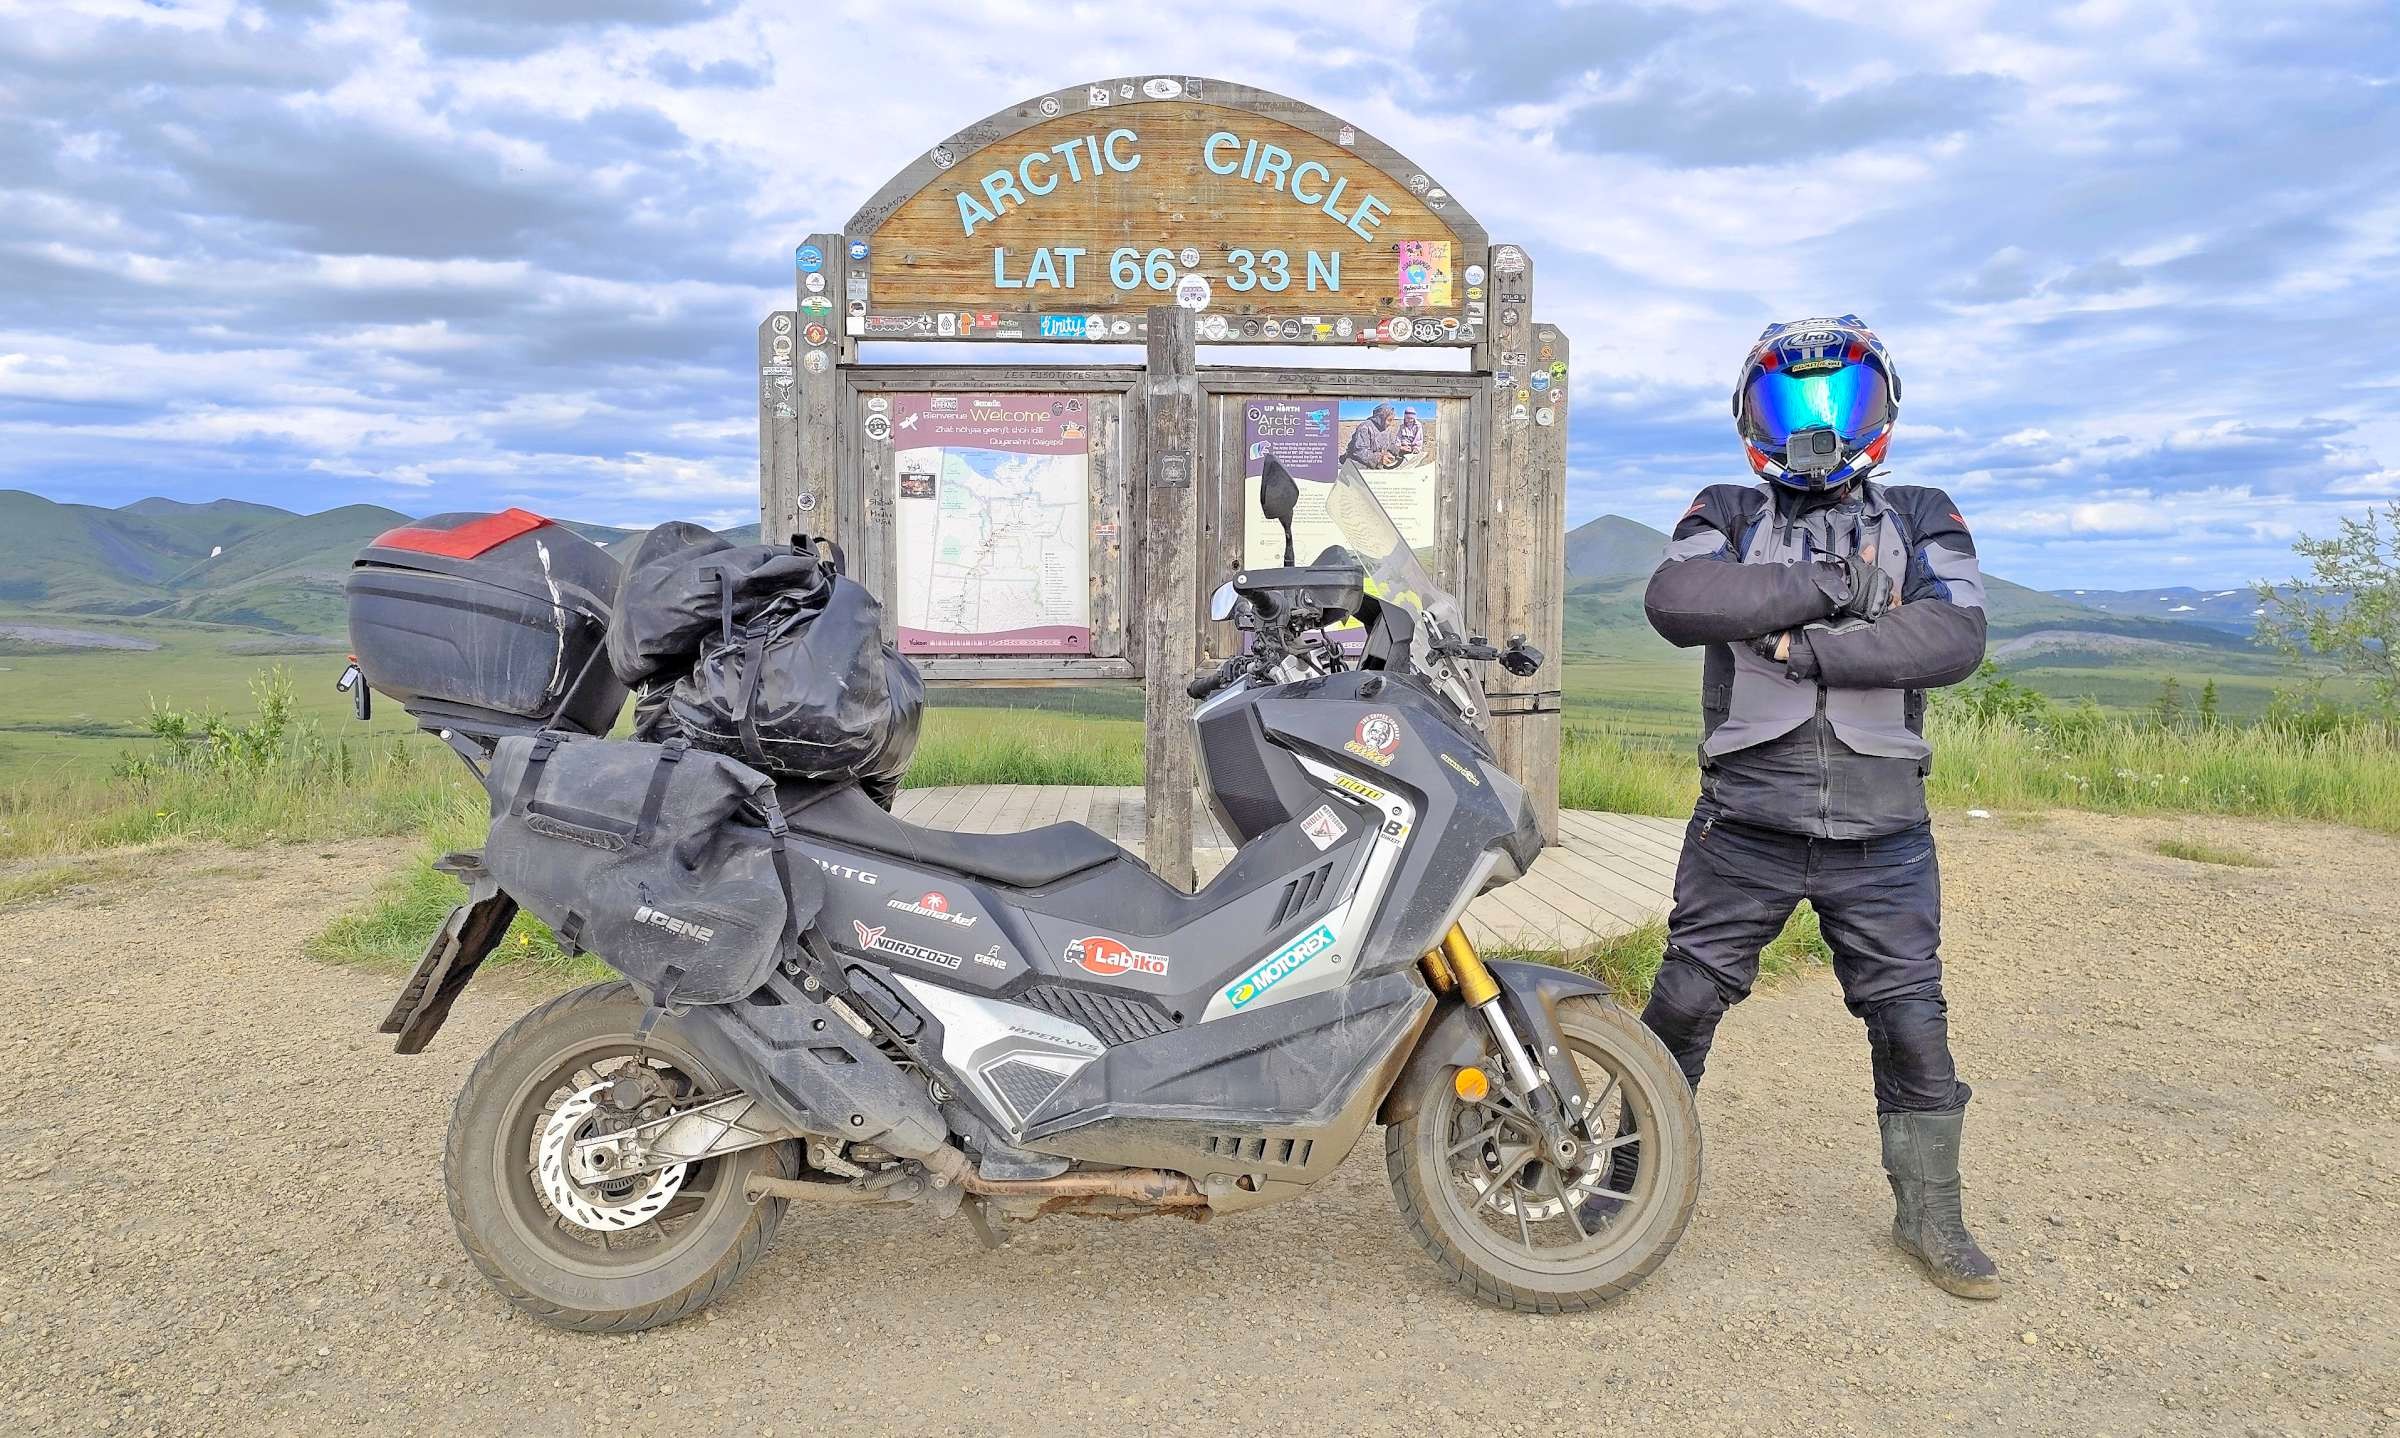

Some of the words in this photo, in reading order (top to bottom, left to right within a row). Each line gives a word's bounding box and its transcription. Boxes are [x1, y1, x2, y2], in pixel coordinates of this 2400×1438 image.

[955, 128, 1142, 238] ARCTIC
[1203, 131, 1392, 243] CIRCLE
[994, 246, 1086, 289] LAT
[1109, 247, 1177, 291] 66
[1226, 248, 1291, 292] 33
[1307, 250, 1341, 292] N
[1414, 323, 1443, 337] 805
[1798, 331, 1831, 342] Arai
[923, 411, 968, 421] Bienvenue
[969, 408, 1051, 423] Welcome
[1258, 414, 1302, 426] Arctic
[1276, 405, 1301, 413] NORTH
[1258, 425, 1295, 436] Circle
[886, 899, 978, 930] motomarket
[649, 910, 715, 943] GEN2
[873, 936, 961, 969] NORDCODE
[973, 953, 1007, 970] GEN2
[1095, 946, 1165, 973] Labiko
[1251, 927, 1332, 992] MOTOREX
